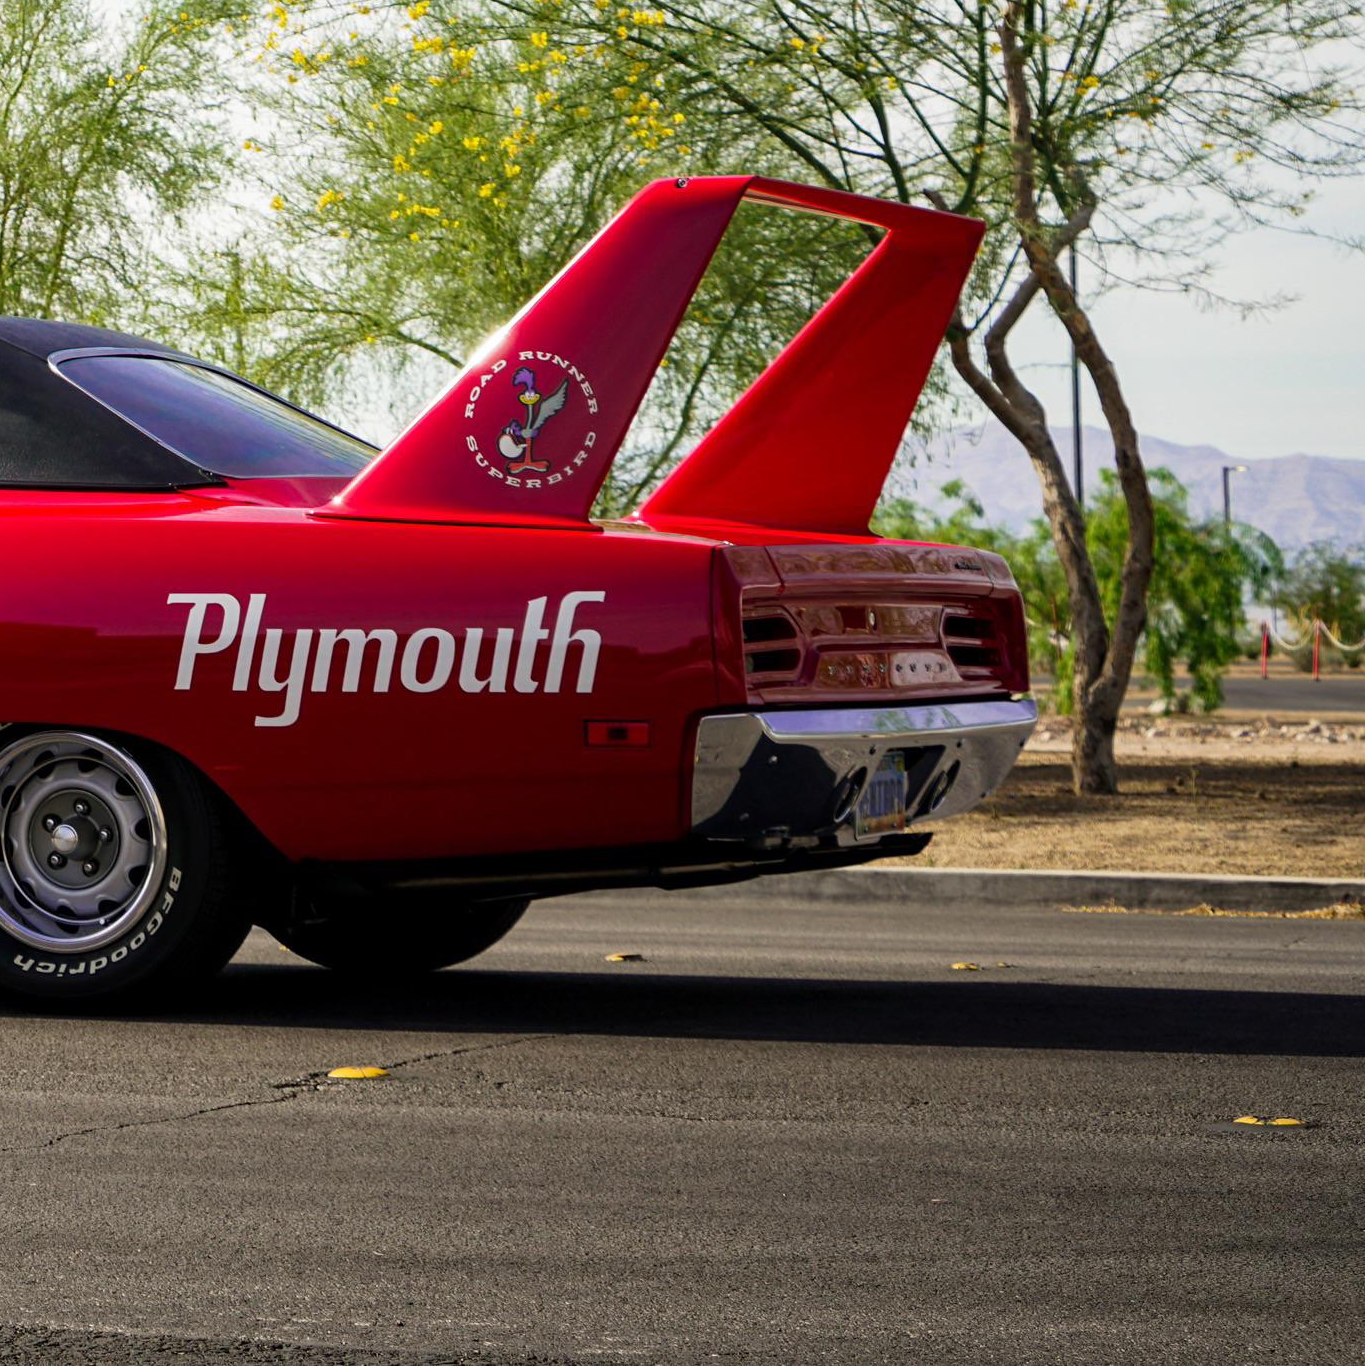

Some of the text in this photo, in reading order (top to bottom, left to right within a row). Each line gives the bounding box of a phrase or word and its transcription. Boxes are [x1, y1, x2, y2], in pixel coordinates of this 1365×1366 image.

[465, 351, 598, 418] ROAD RUNNER
[466, 431, 597, 489] SUPERBIRD
[166, 591, 606, 727] Plymouth
[13, 866, 182, 977] BFGoodrich
